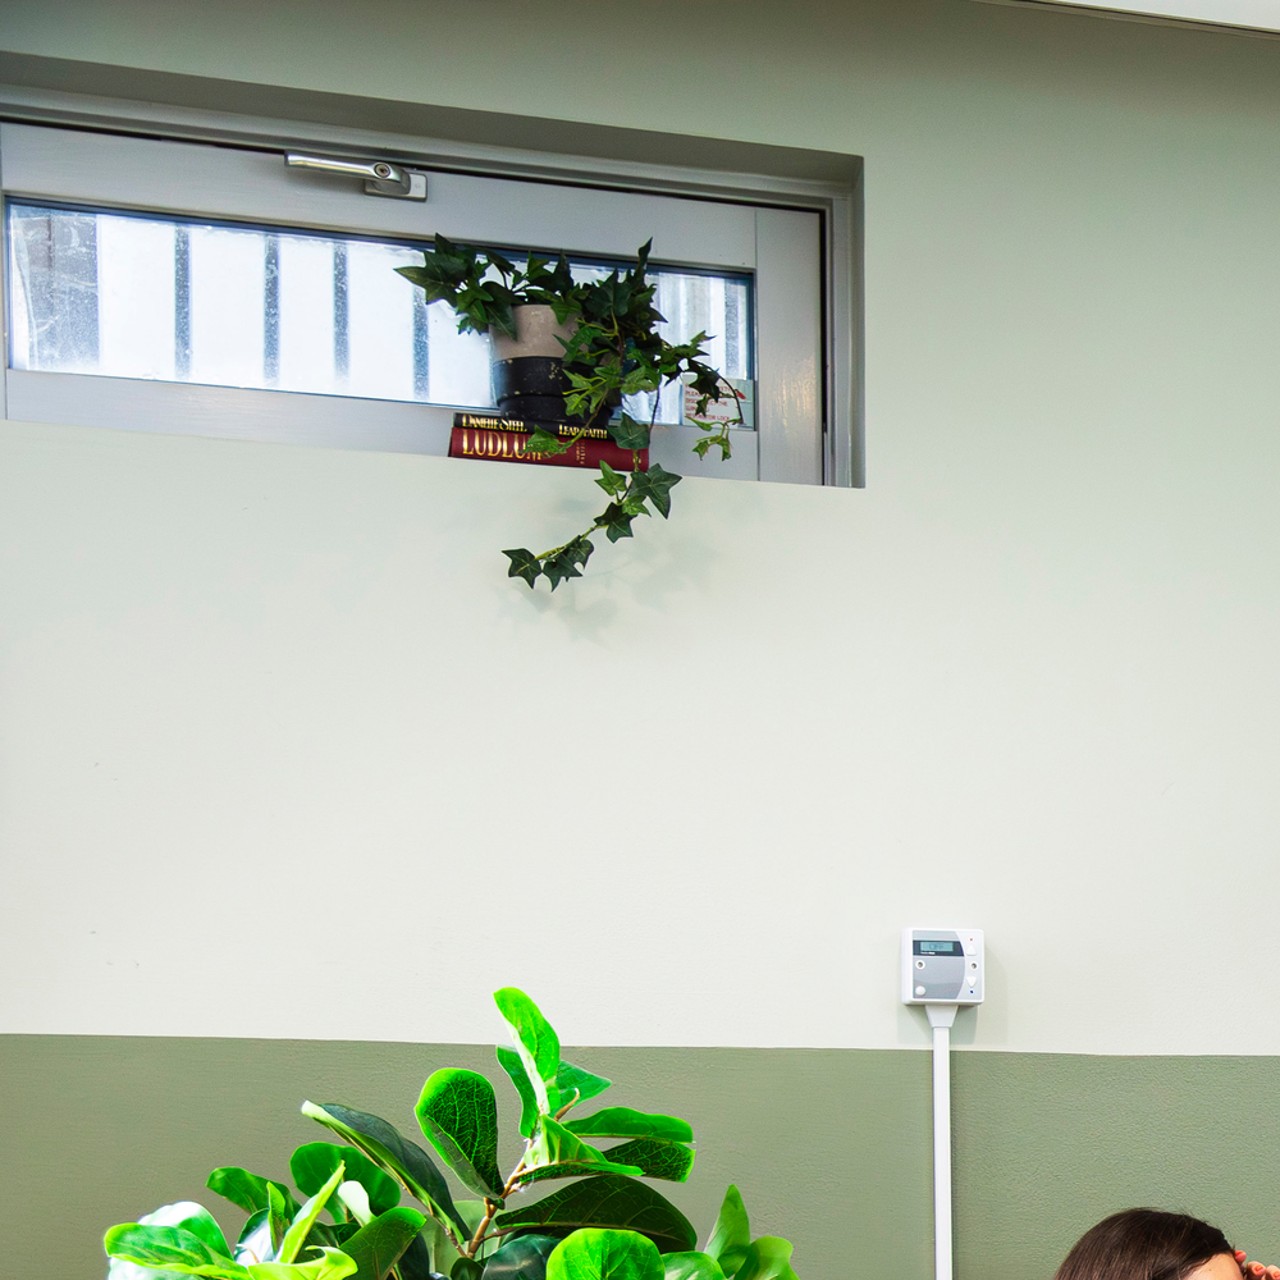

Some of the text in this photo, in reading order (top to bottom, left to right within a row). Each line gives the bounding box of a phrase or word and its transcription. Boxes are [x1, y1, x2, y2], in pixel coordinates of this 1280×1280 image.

[461, 414, 528, 433] DANIELLE STEEL
[558, 424, 579, 437] LEAP
